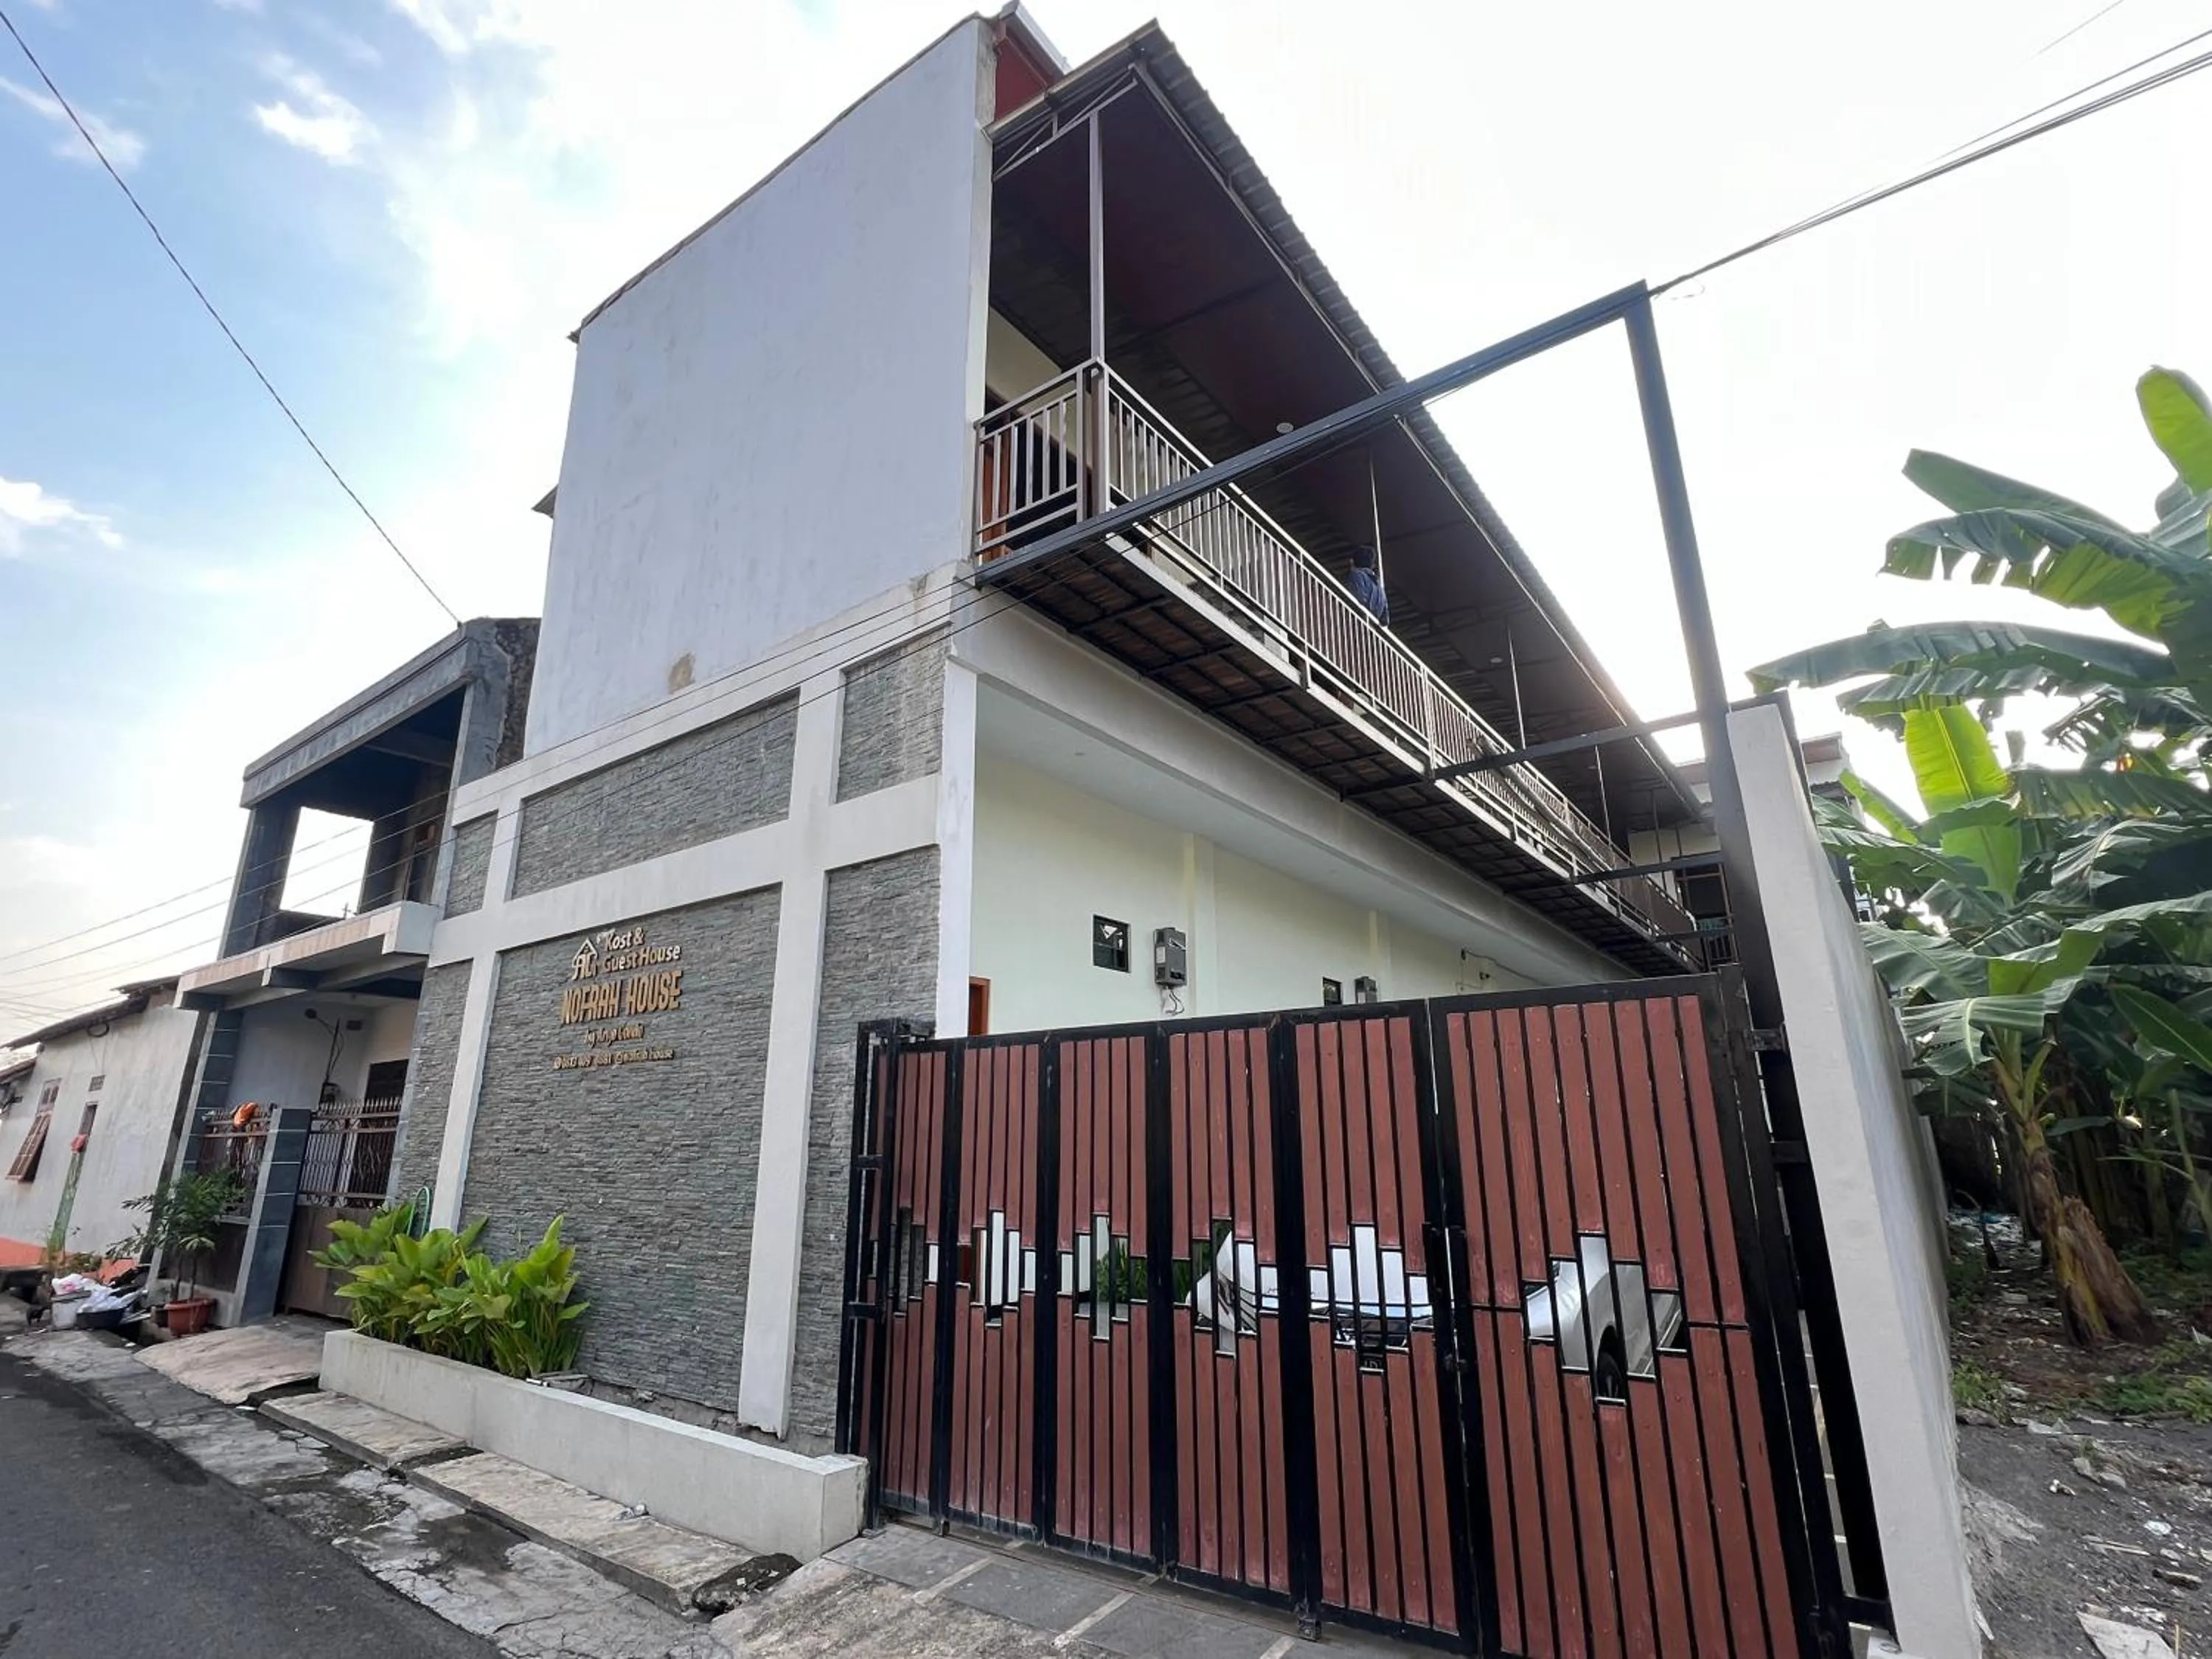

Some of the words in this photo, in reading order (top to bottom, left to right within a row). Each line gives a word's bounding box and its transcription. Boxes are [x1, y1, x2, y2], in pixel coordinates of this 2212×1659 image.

[599, 928, 632, 951] Kost
[633, 927, 644, 945] &
[602, 951, 637, 973] Guest
[639, 945, 681, 966] House
[560, 980, 621, 1024] NOFRAH
[627, 970, 683, 1015] HOUSE
